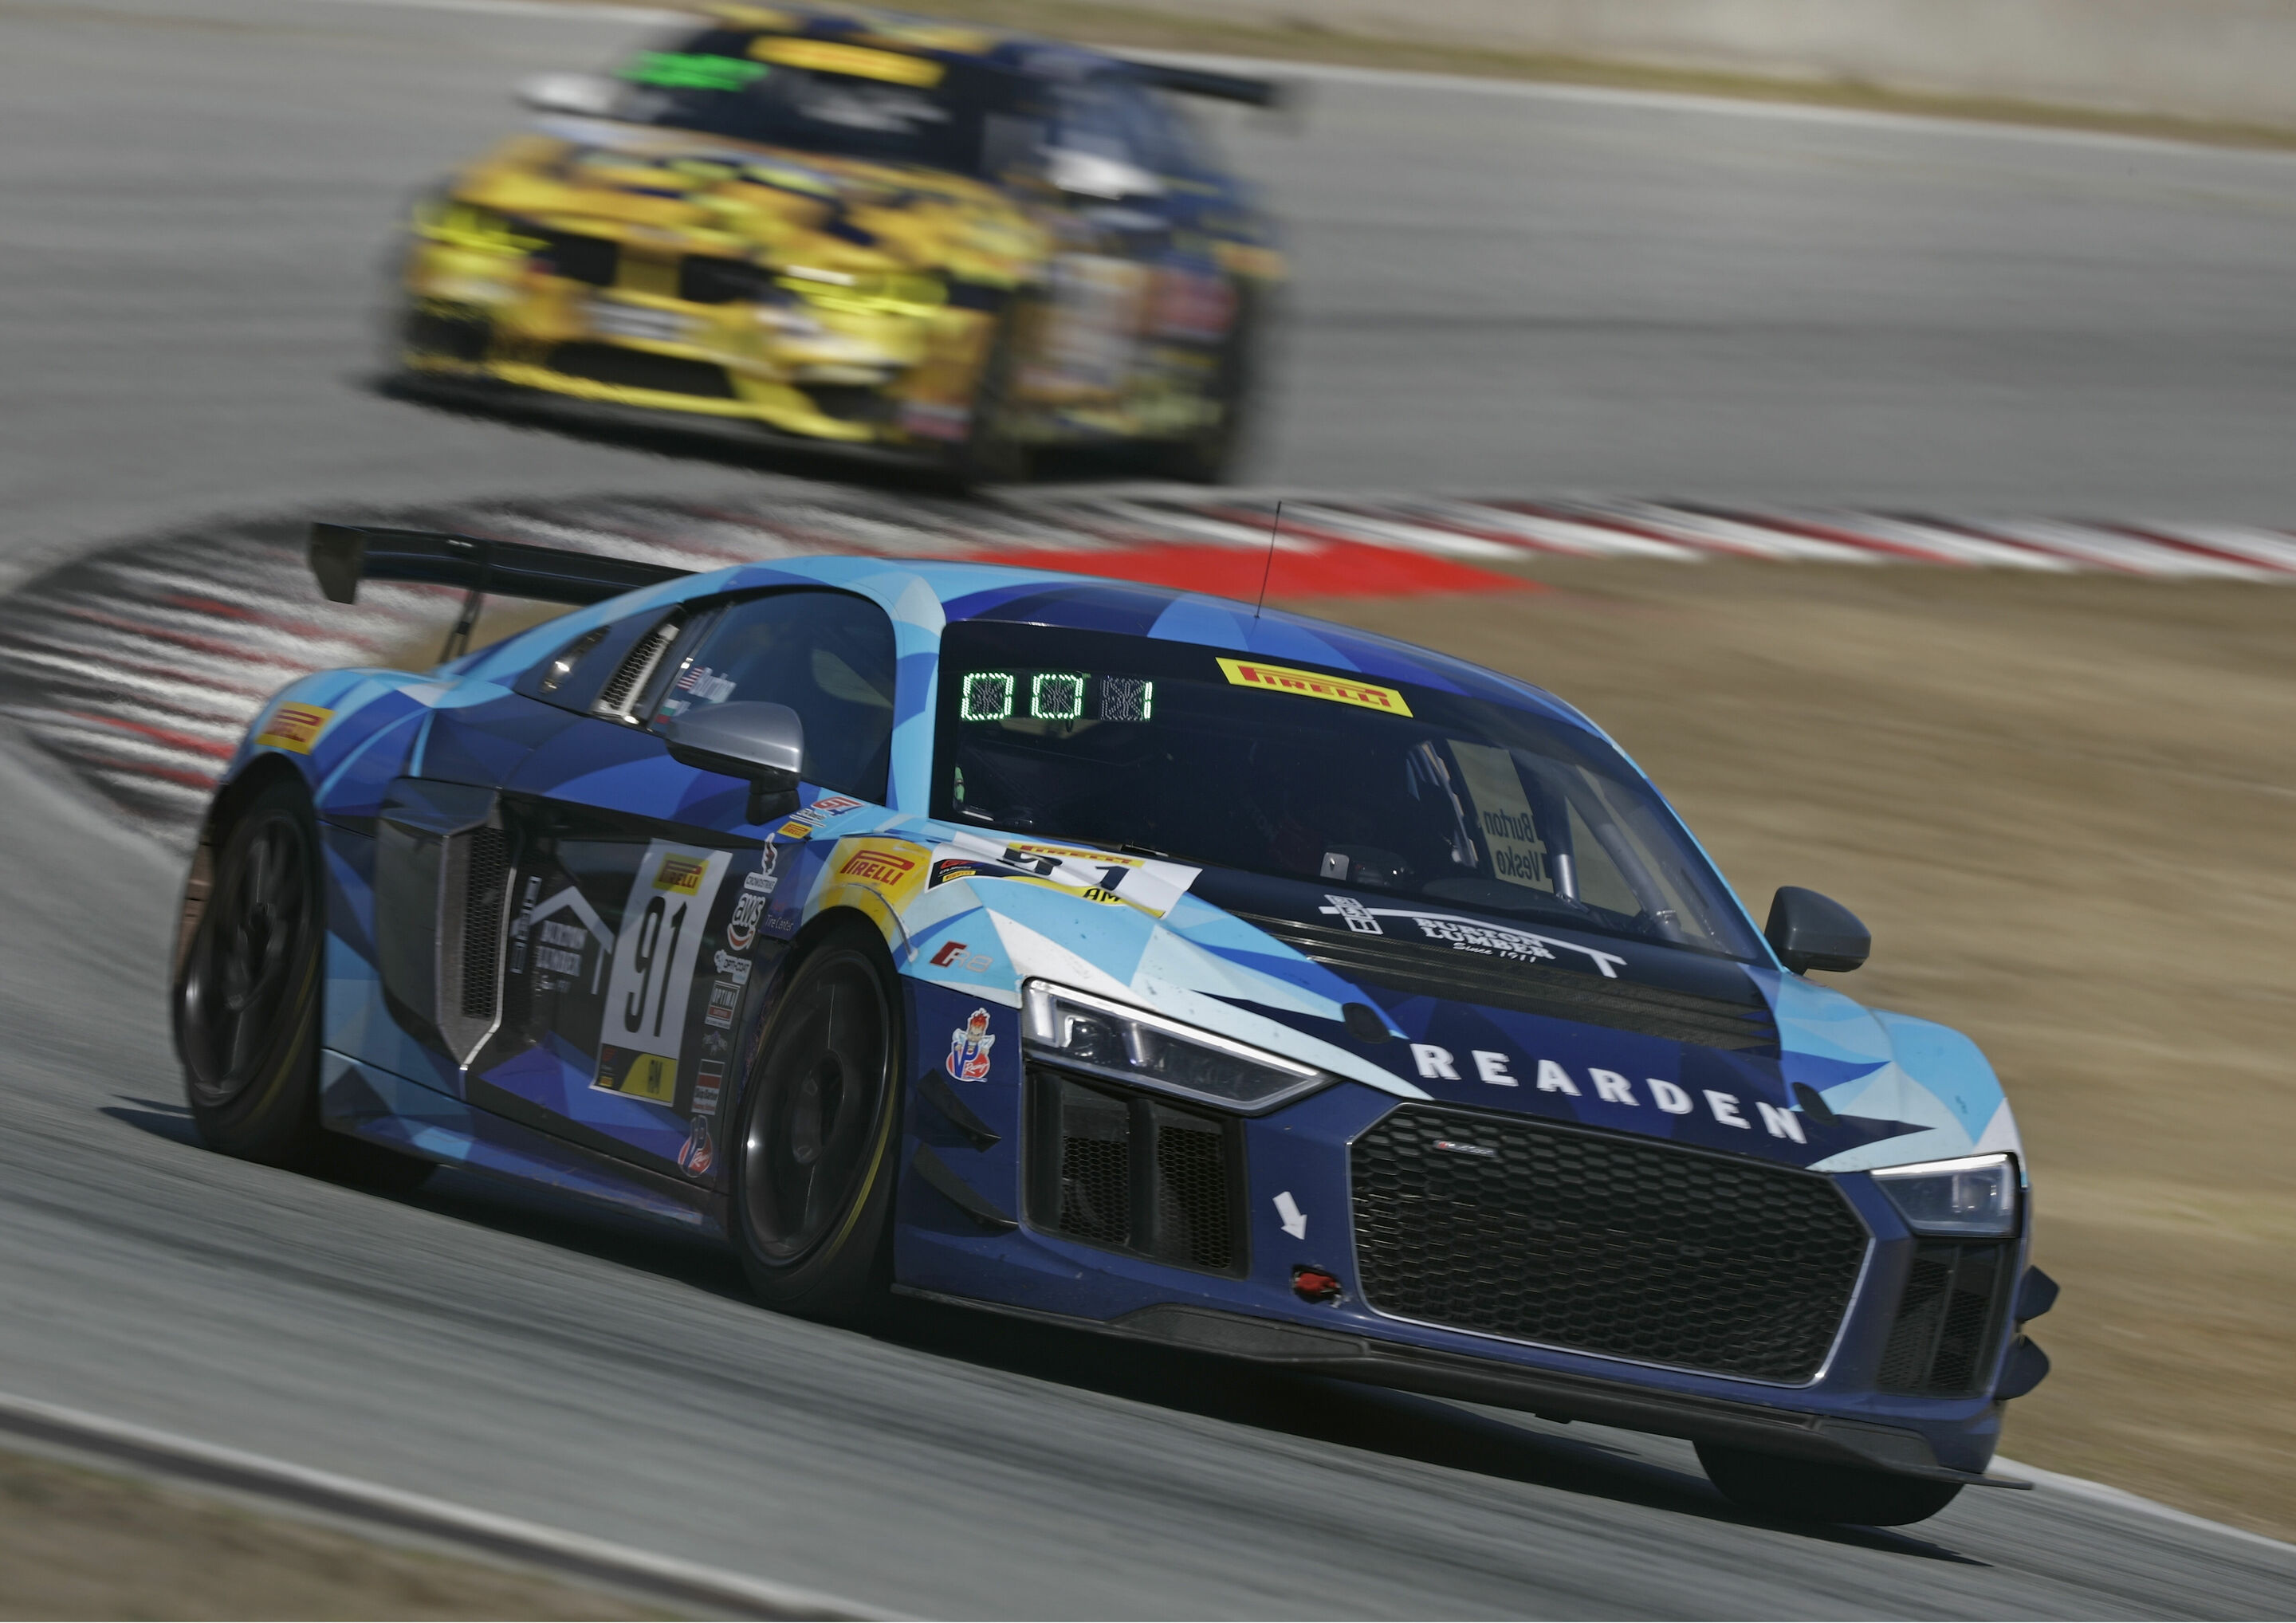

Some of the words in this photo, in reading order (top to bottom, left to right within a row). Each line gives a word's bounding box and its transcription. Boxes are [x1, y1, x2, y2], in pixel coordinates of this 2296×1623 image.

[1237, 665, 1392, 708] PIRELLI
[659, 859, 702, 889] PIRELLI
[840, 849, 915, 886] PIRELLI
[732, 893, 766, 929] aws
[1083, 888, 1122, 902] AM
[776, 917, 795, 932] Center
[1412, 918, 1544, 948] BURTON
[1421, 926, 1557, 960] LUMBER
[1453, 942, 1493, 955] Since
[1500, 950, 1536, 963] 1911
[624, 896, 687, 1038] 91
[1409, 1043, 1807, 1145] REARDEN
